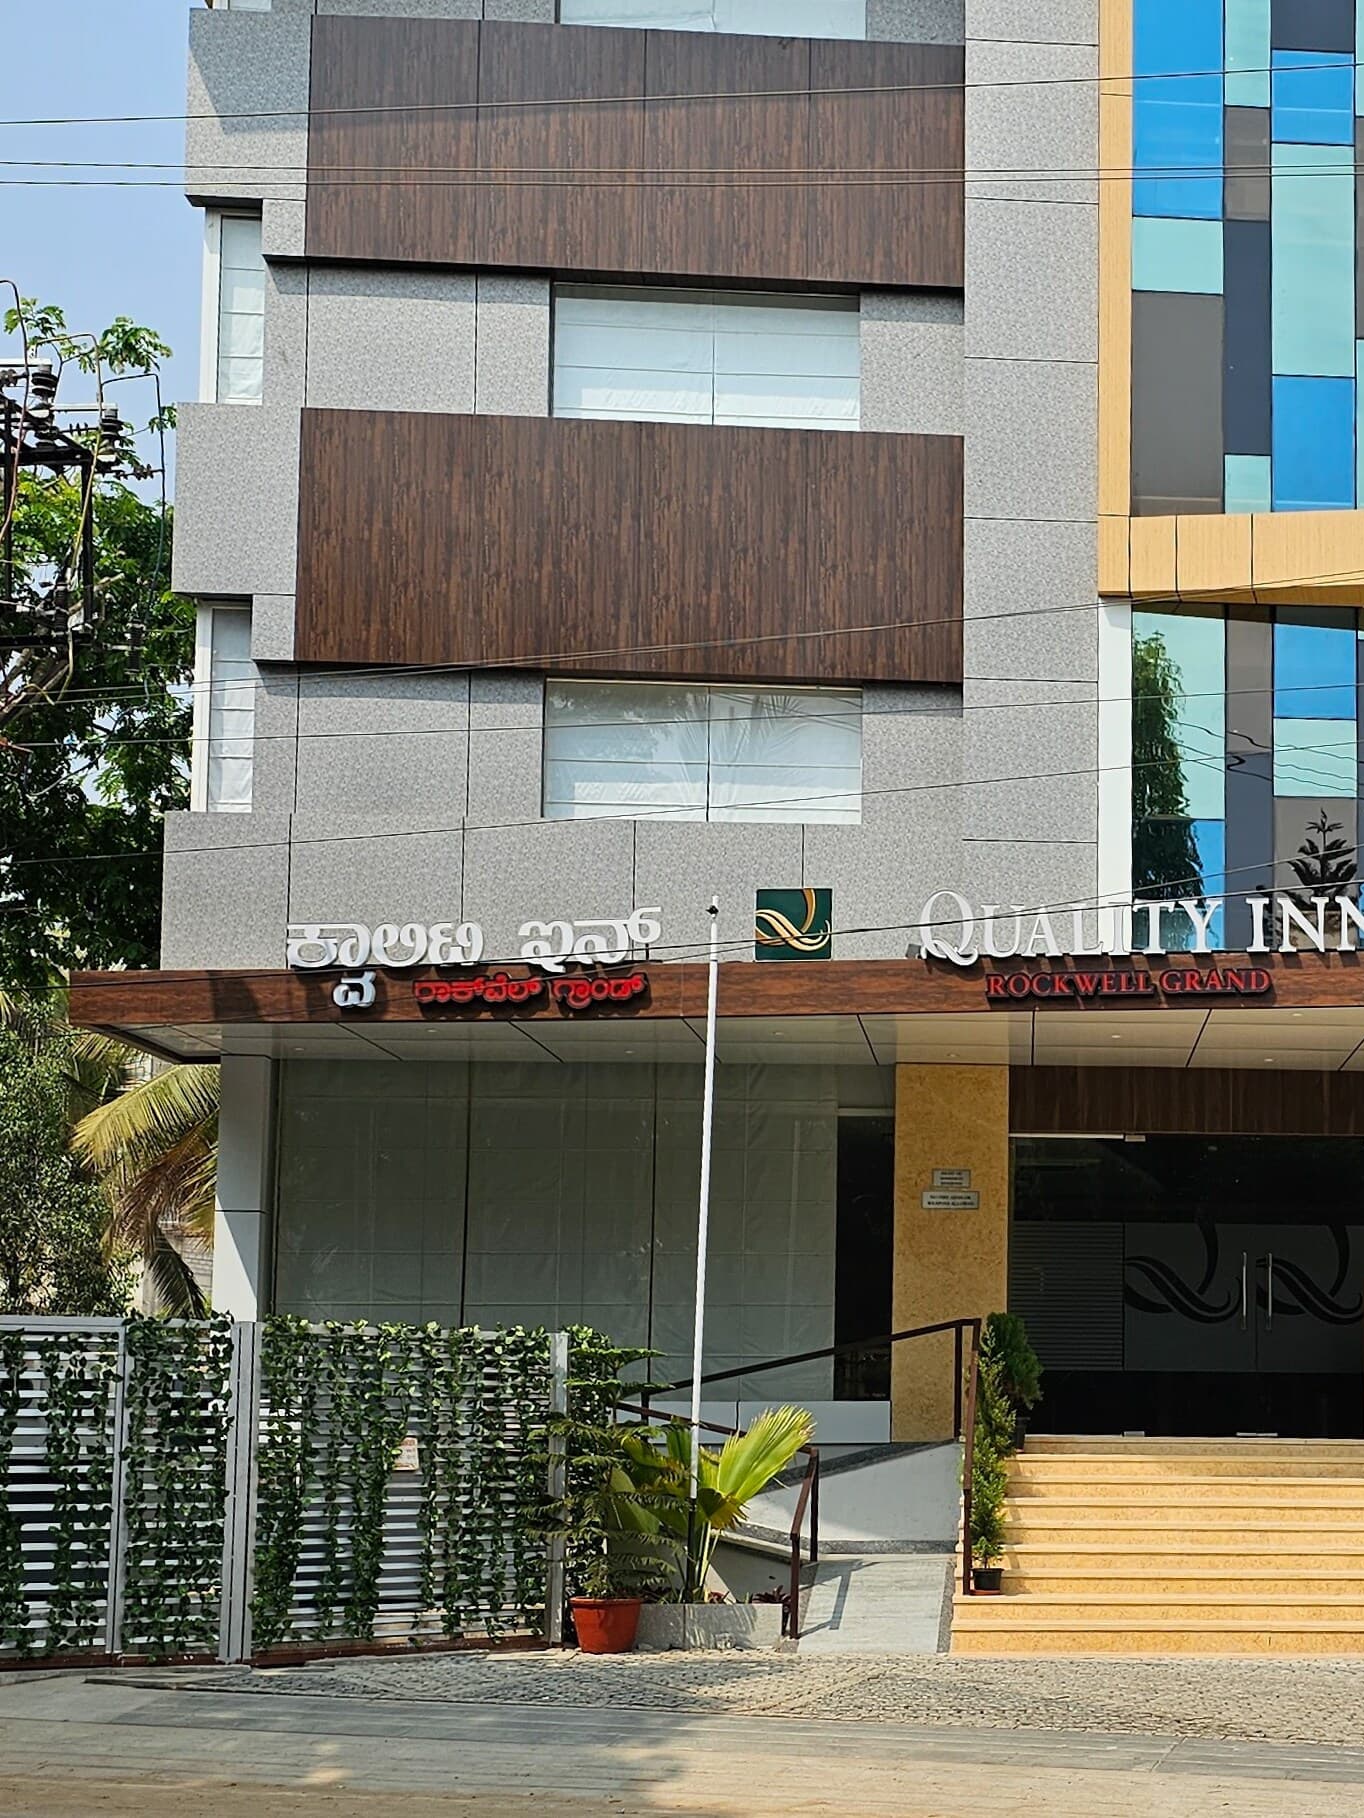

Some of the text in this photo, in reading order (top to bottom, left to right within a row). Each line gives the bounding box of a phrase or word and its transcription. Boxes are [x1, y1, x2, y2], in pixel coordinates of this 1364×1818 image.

[518, 906, 662, 973] ಇನ್
[917, 890, 1223, 966] QUALITY
[987, 969, 1272, 998] ROCKWELL GRAND
